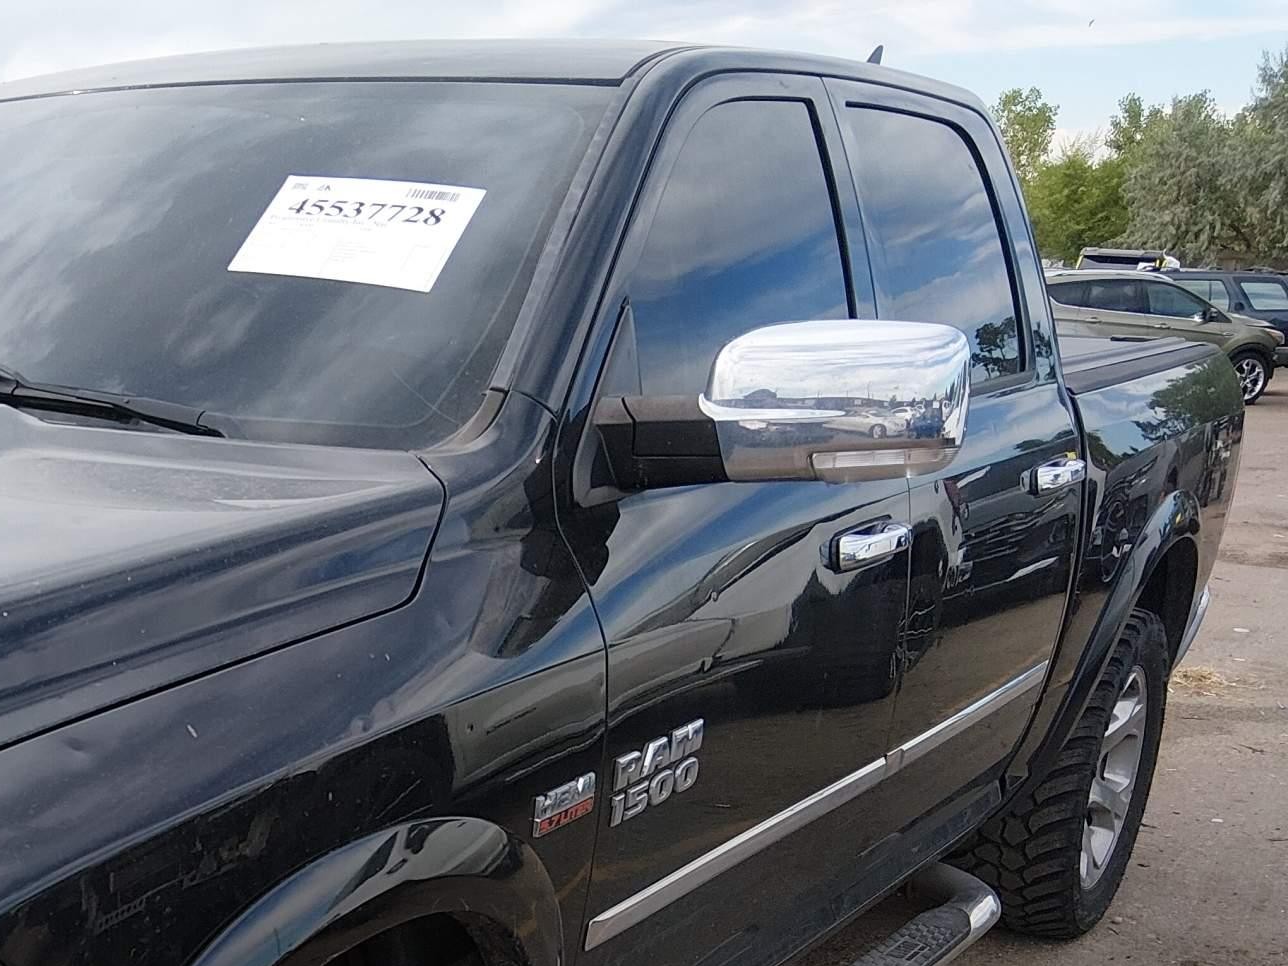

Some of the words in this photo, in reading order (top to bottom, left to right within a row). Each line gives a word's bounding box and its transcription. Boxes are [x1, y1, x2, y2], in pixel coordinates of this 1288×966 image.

[288, 198, 447, 226] 45537728
[613, 718, 705, 792] RAM
[535, 772, 596, 820] HEMI
[609, 757, 700, 827] 1500
